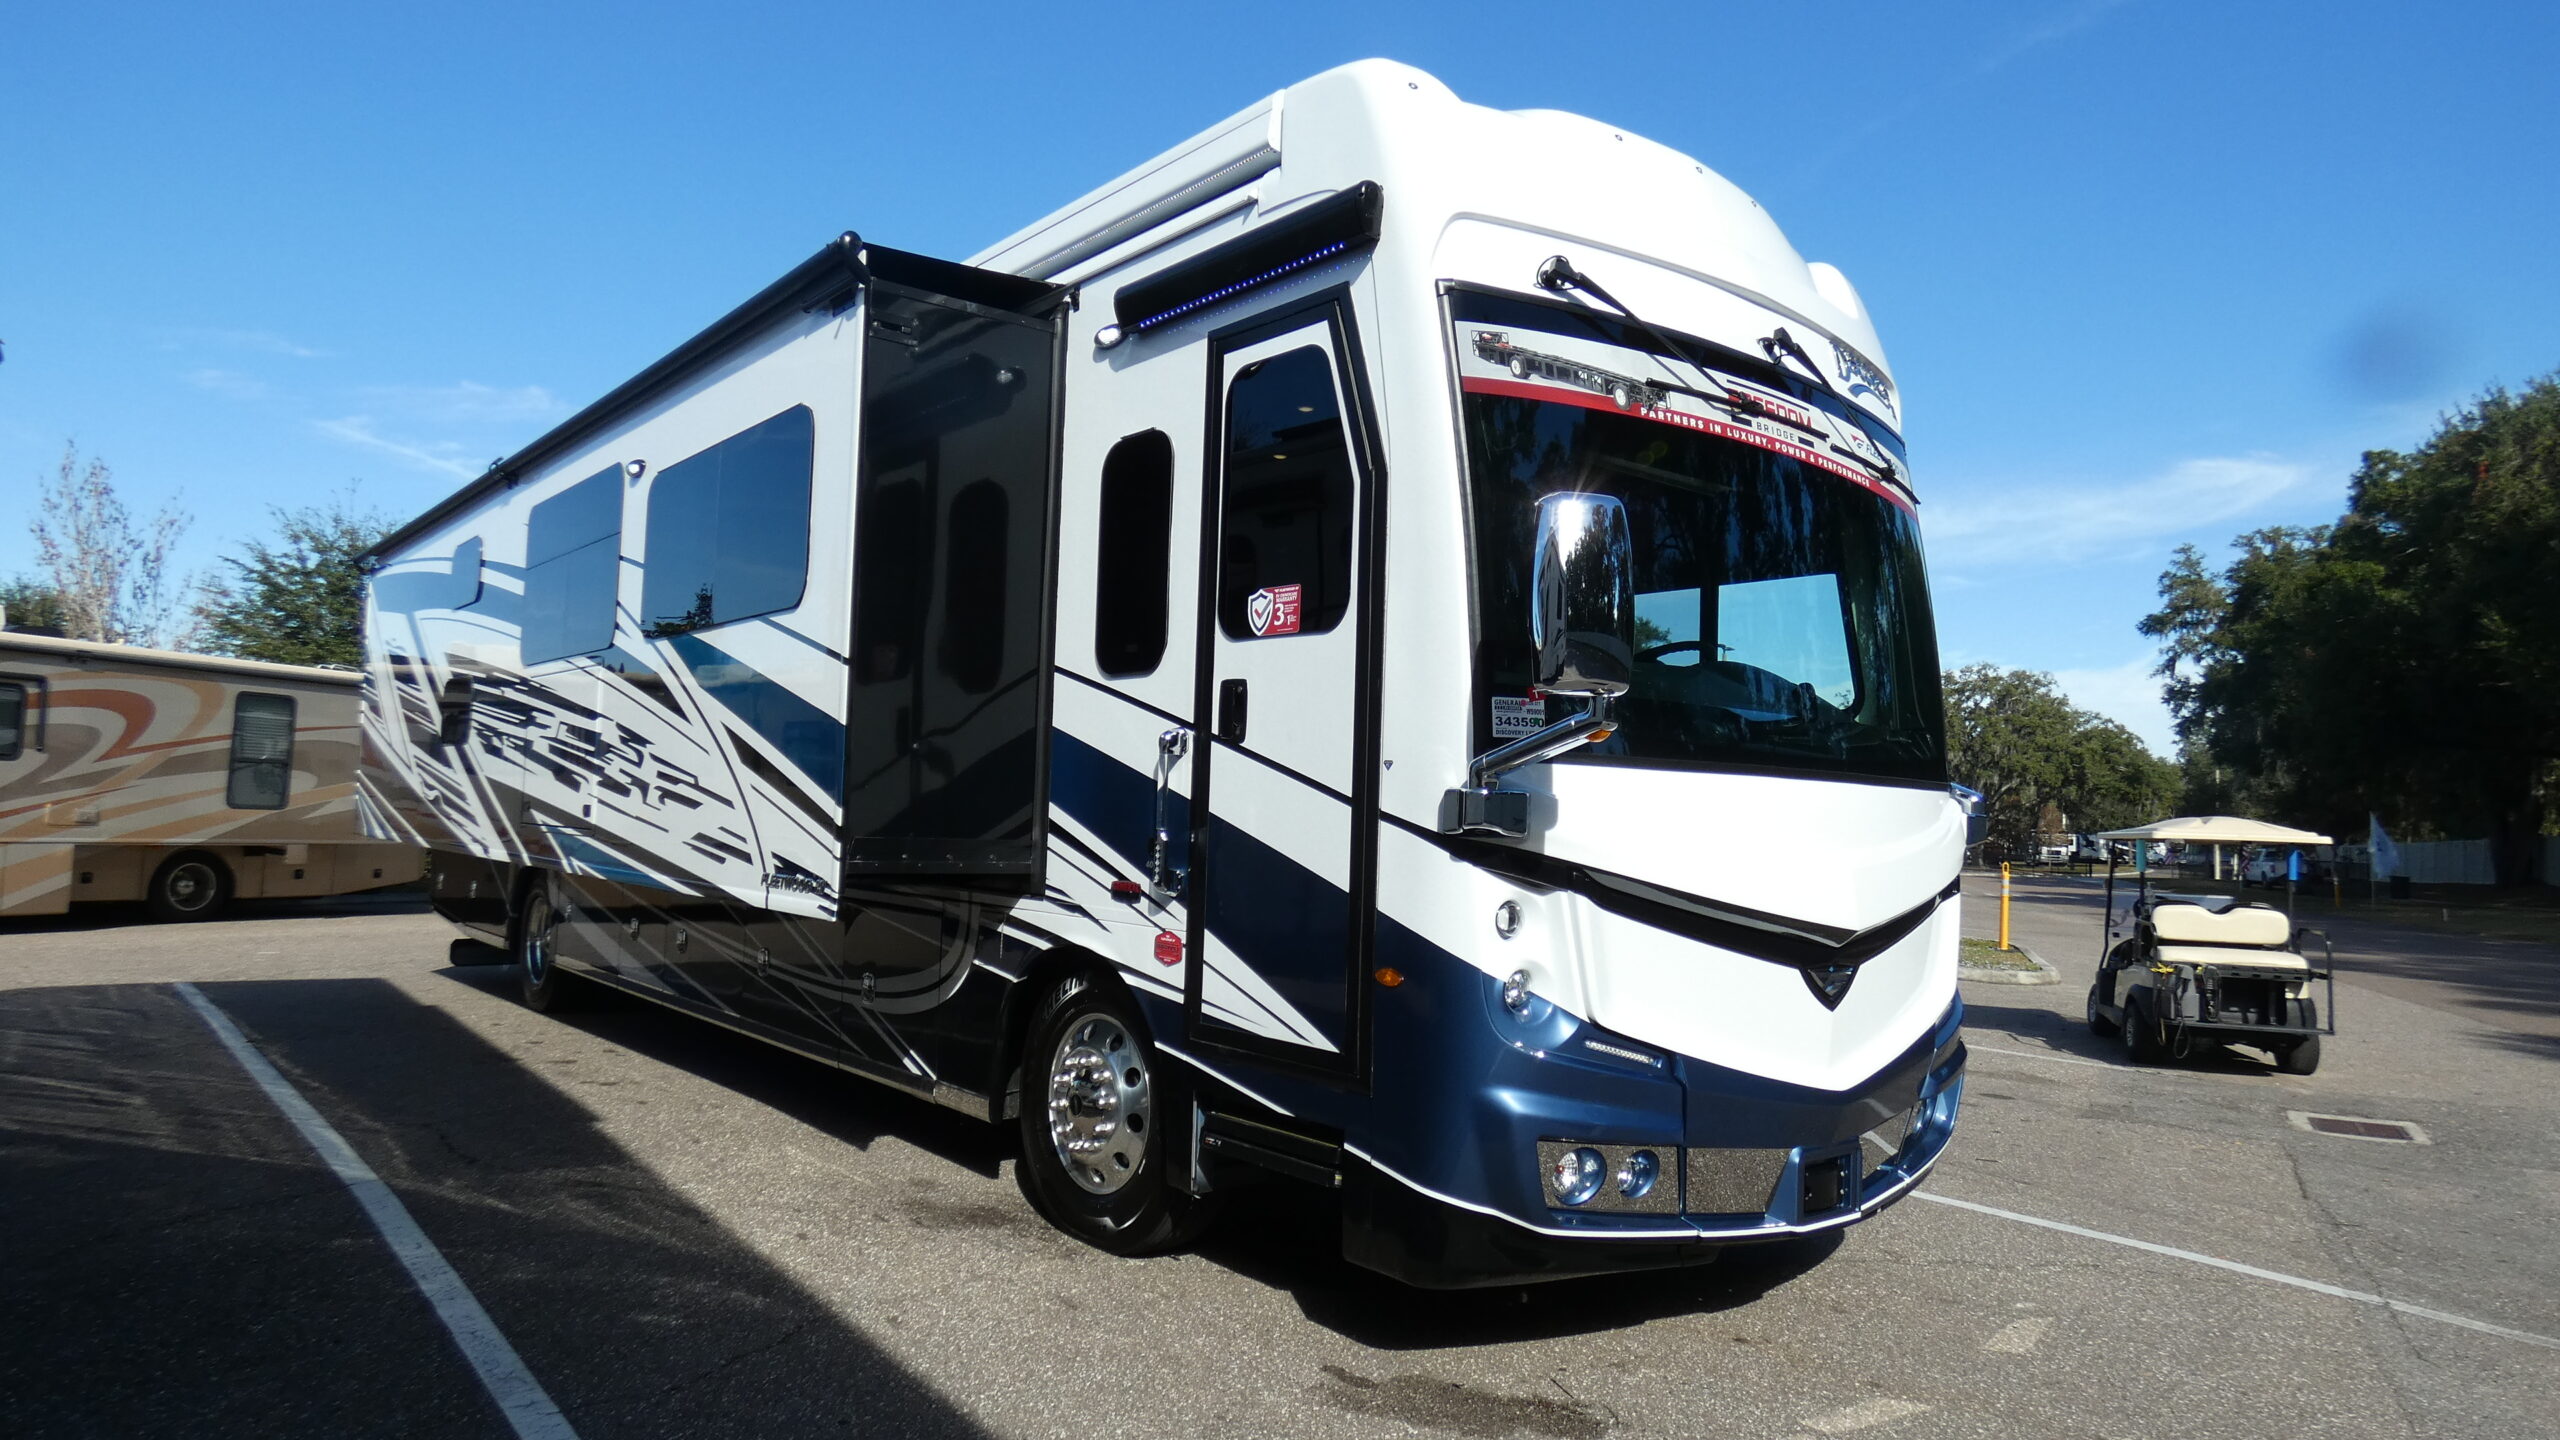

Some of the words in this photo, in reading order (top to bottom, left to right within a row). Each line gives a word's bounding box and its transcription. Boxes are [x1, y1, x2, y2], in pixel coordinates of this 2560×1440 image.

[1756, 421, 1795, 442] BRIDGE
[1640, 407, 1705, 429] PARTNERS
[1709, 423, 1721, 433] IN
[1727, 427, 1772, 449] LUXURY,
[1775, 442, 1806, 459] POWER
[1809, 454, 1815, 462] &
[1818, 457, 1870, 487] PERFORMANCE
[1274, 603, 1285, 625] 3
[1495, 716, 1544, 728] 343590
[760, 873, 812, 894] FLEETWOOD
